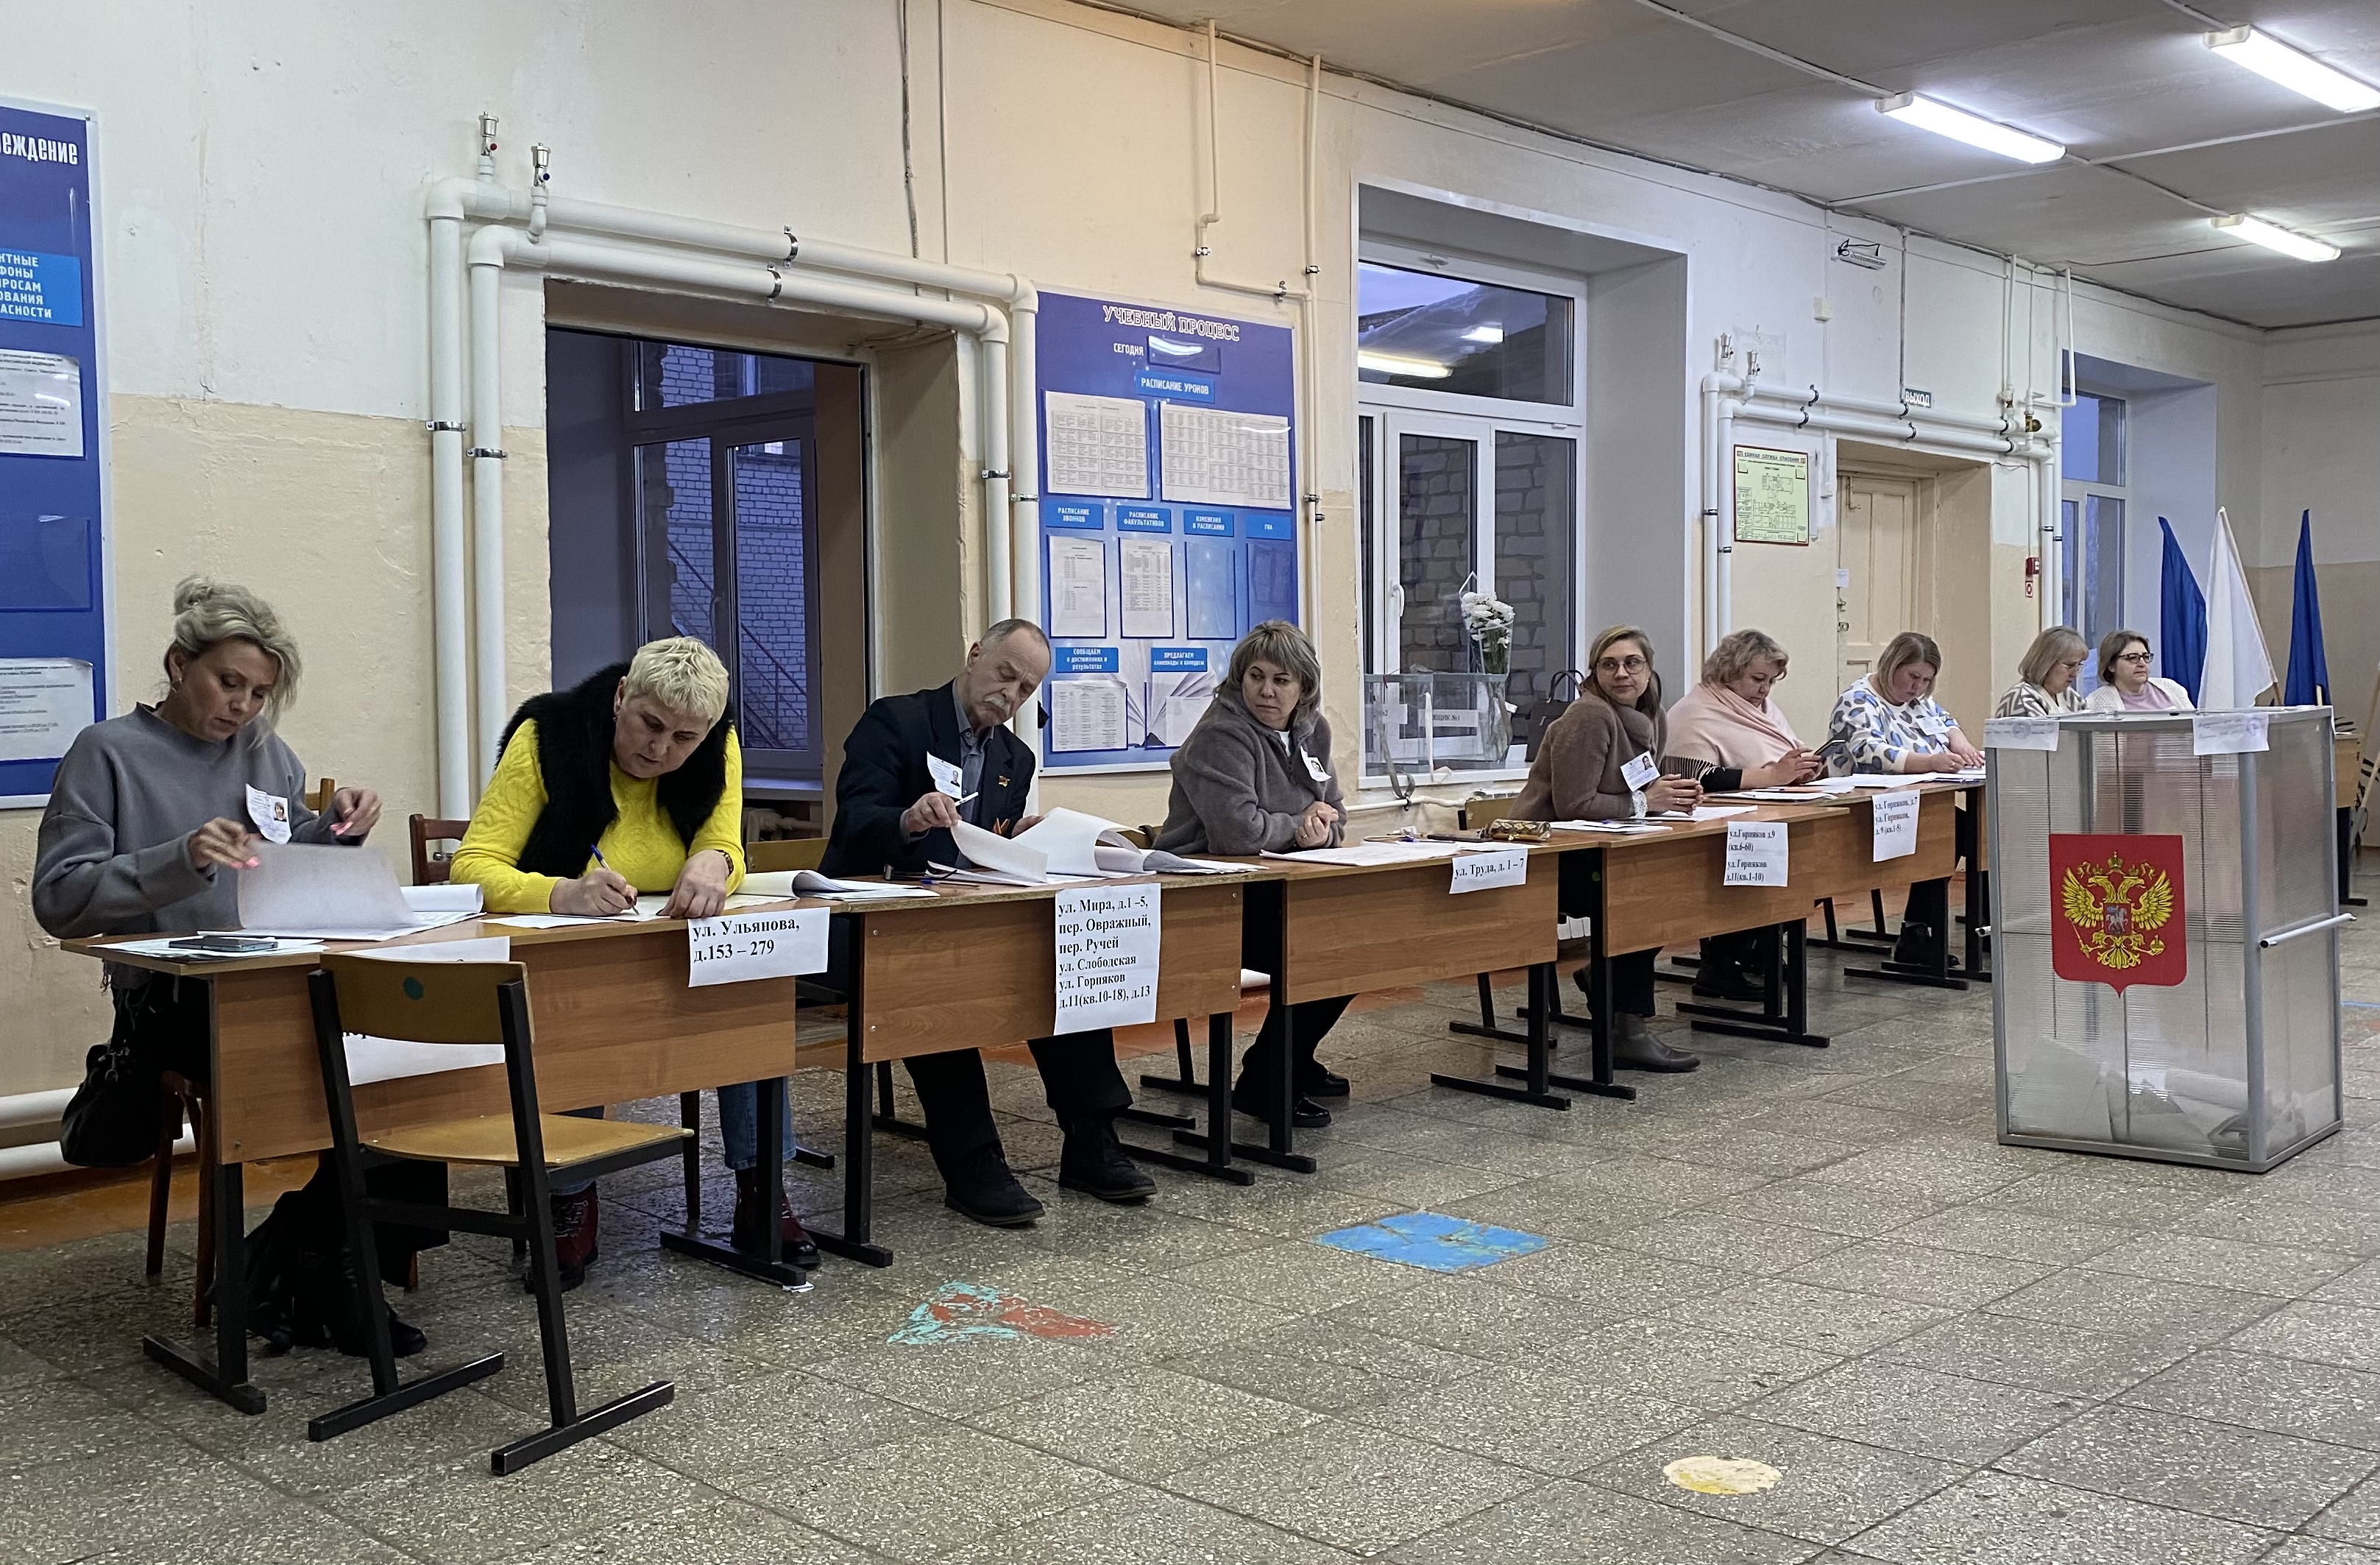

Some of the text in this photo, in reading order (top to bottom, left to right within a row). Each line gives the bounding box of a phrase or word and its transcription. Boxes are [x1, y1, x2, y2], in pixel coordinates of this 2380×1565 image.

[0, 133, 77, 165] еждение
[0, 278, 41, 292] РОСАМ
[0, 303, 52, 318] АСНОСТИ
[1103, 305, 1240, 341] УЧЕБНЫЙ ПРОЦЕСС
[1113, 342, 1144, 356] СЕГОДНЯ
[1141, 377, 1209, 395] РАСПИСАНИЕ УРОКОВ
[1905, 390, 1930, 407] ВЫХОД
[1058, 506, 1090, 515] РАСПИСАНИЕ
[1129, 511, 1159, 520] РАСПИСАНИЕ
[1123, 518, 1165, 527] ФАКУЛЬТАТИВОВ
[1454, 869, 1467, 879] ул.
[1470, 863, 1496, 877] Труда,
[1498, 863, 1505, 872] д.
[1520, 858, 1524, 868] 7
[1058, 904, 1076, 917] ул.
[1080, 899, 1115, 914] Мира,
[1118, 897, 1131, 911] д.1
[693, 919, 800, 942] ул. Ульянова,
[1059, 914, 1151, 936] пер. Овражный,
[693, 943, 733, 963] д.153
[750, 939, 774, 955] 279
[1059, 936, 1119, 956] пер. Ручей
[1059, 955, 1136, 975] ул. Слободская
[1059, 973, 1126, 992] ул. Горняков
[1059, 985, 1150, 1009] д.11(кв.10-18), д.13
